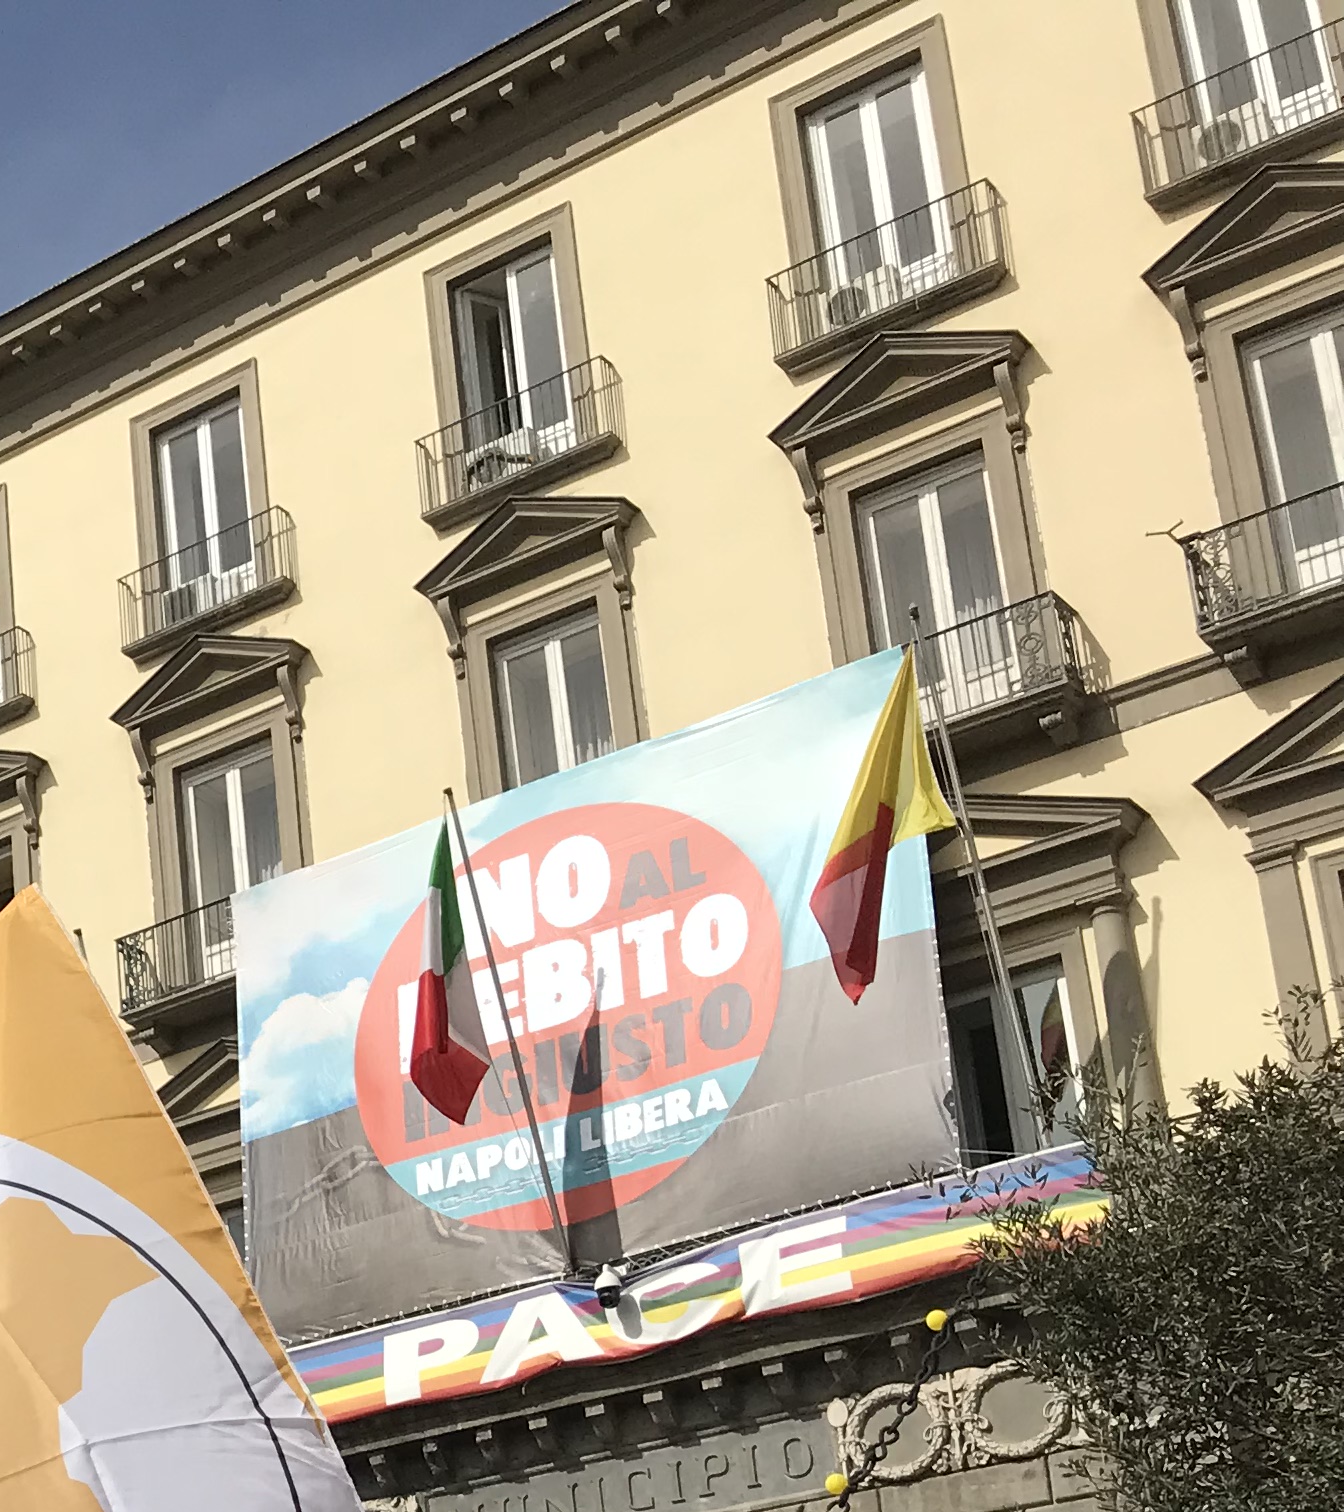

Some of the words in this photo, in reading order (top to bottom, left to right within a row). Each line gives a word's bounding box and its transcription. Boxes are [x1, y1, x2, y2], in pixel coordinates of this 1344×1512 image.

[456, 834, 612, 959] NO
[618, 836, 708, 911] AL
[415, 1124, 567, 1197] NAPOLI
[578, 1077, 730, 1153] LIBERA
[383, 1215, 855, 1408] PACE
